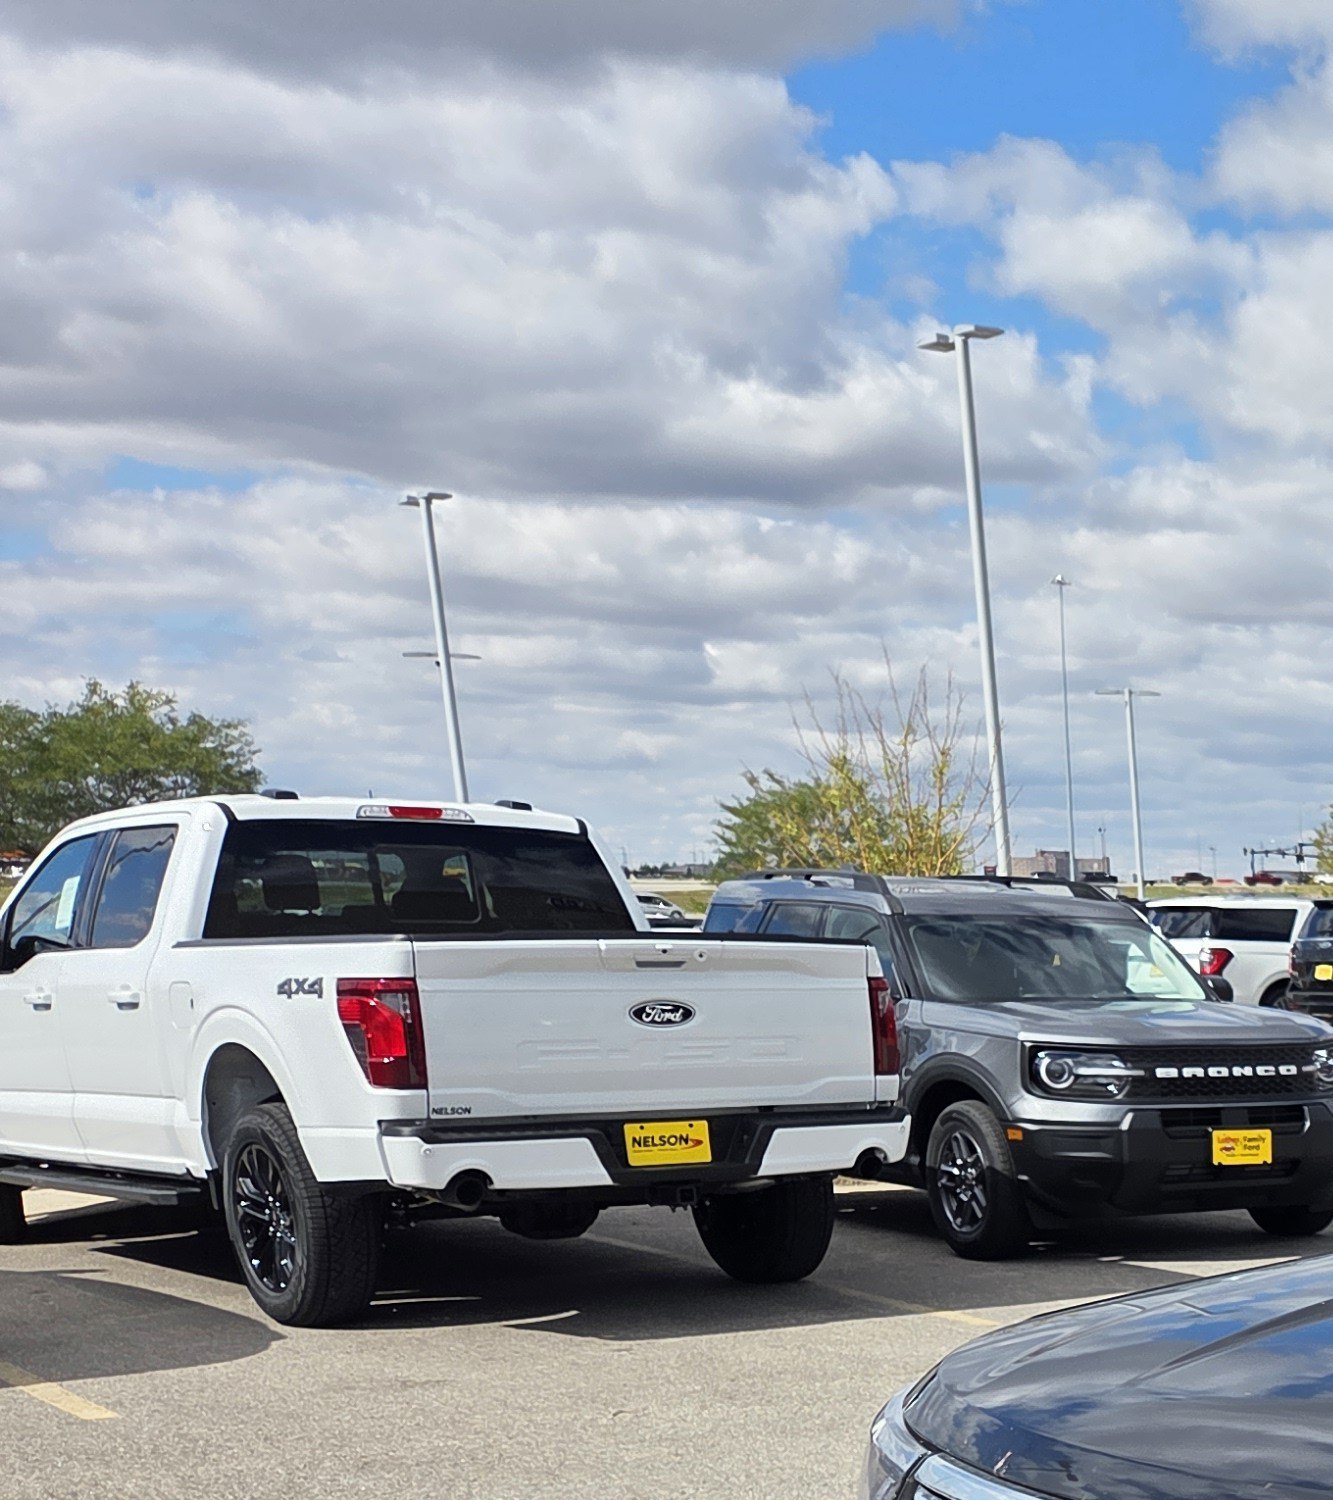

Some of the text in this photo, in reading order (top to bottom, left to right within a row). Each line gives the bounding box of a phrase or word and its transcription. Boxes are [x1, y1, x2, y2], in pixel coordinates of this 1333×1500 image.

[641, 1005, 684, 1022] Ford
[1155, 1065, 1297, 1078] BRONCO
[431, 1106, 472, 1116] NELSON
[631, 1133, 689, 1149] NELSON
